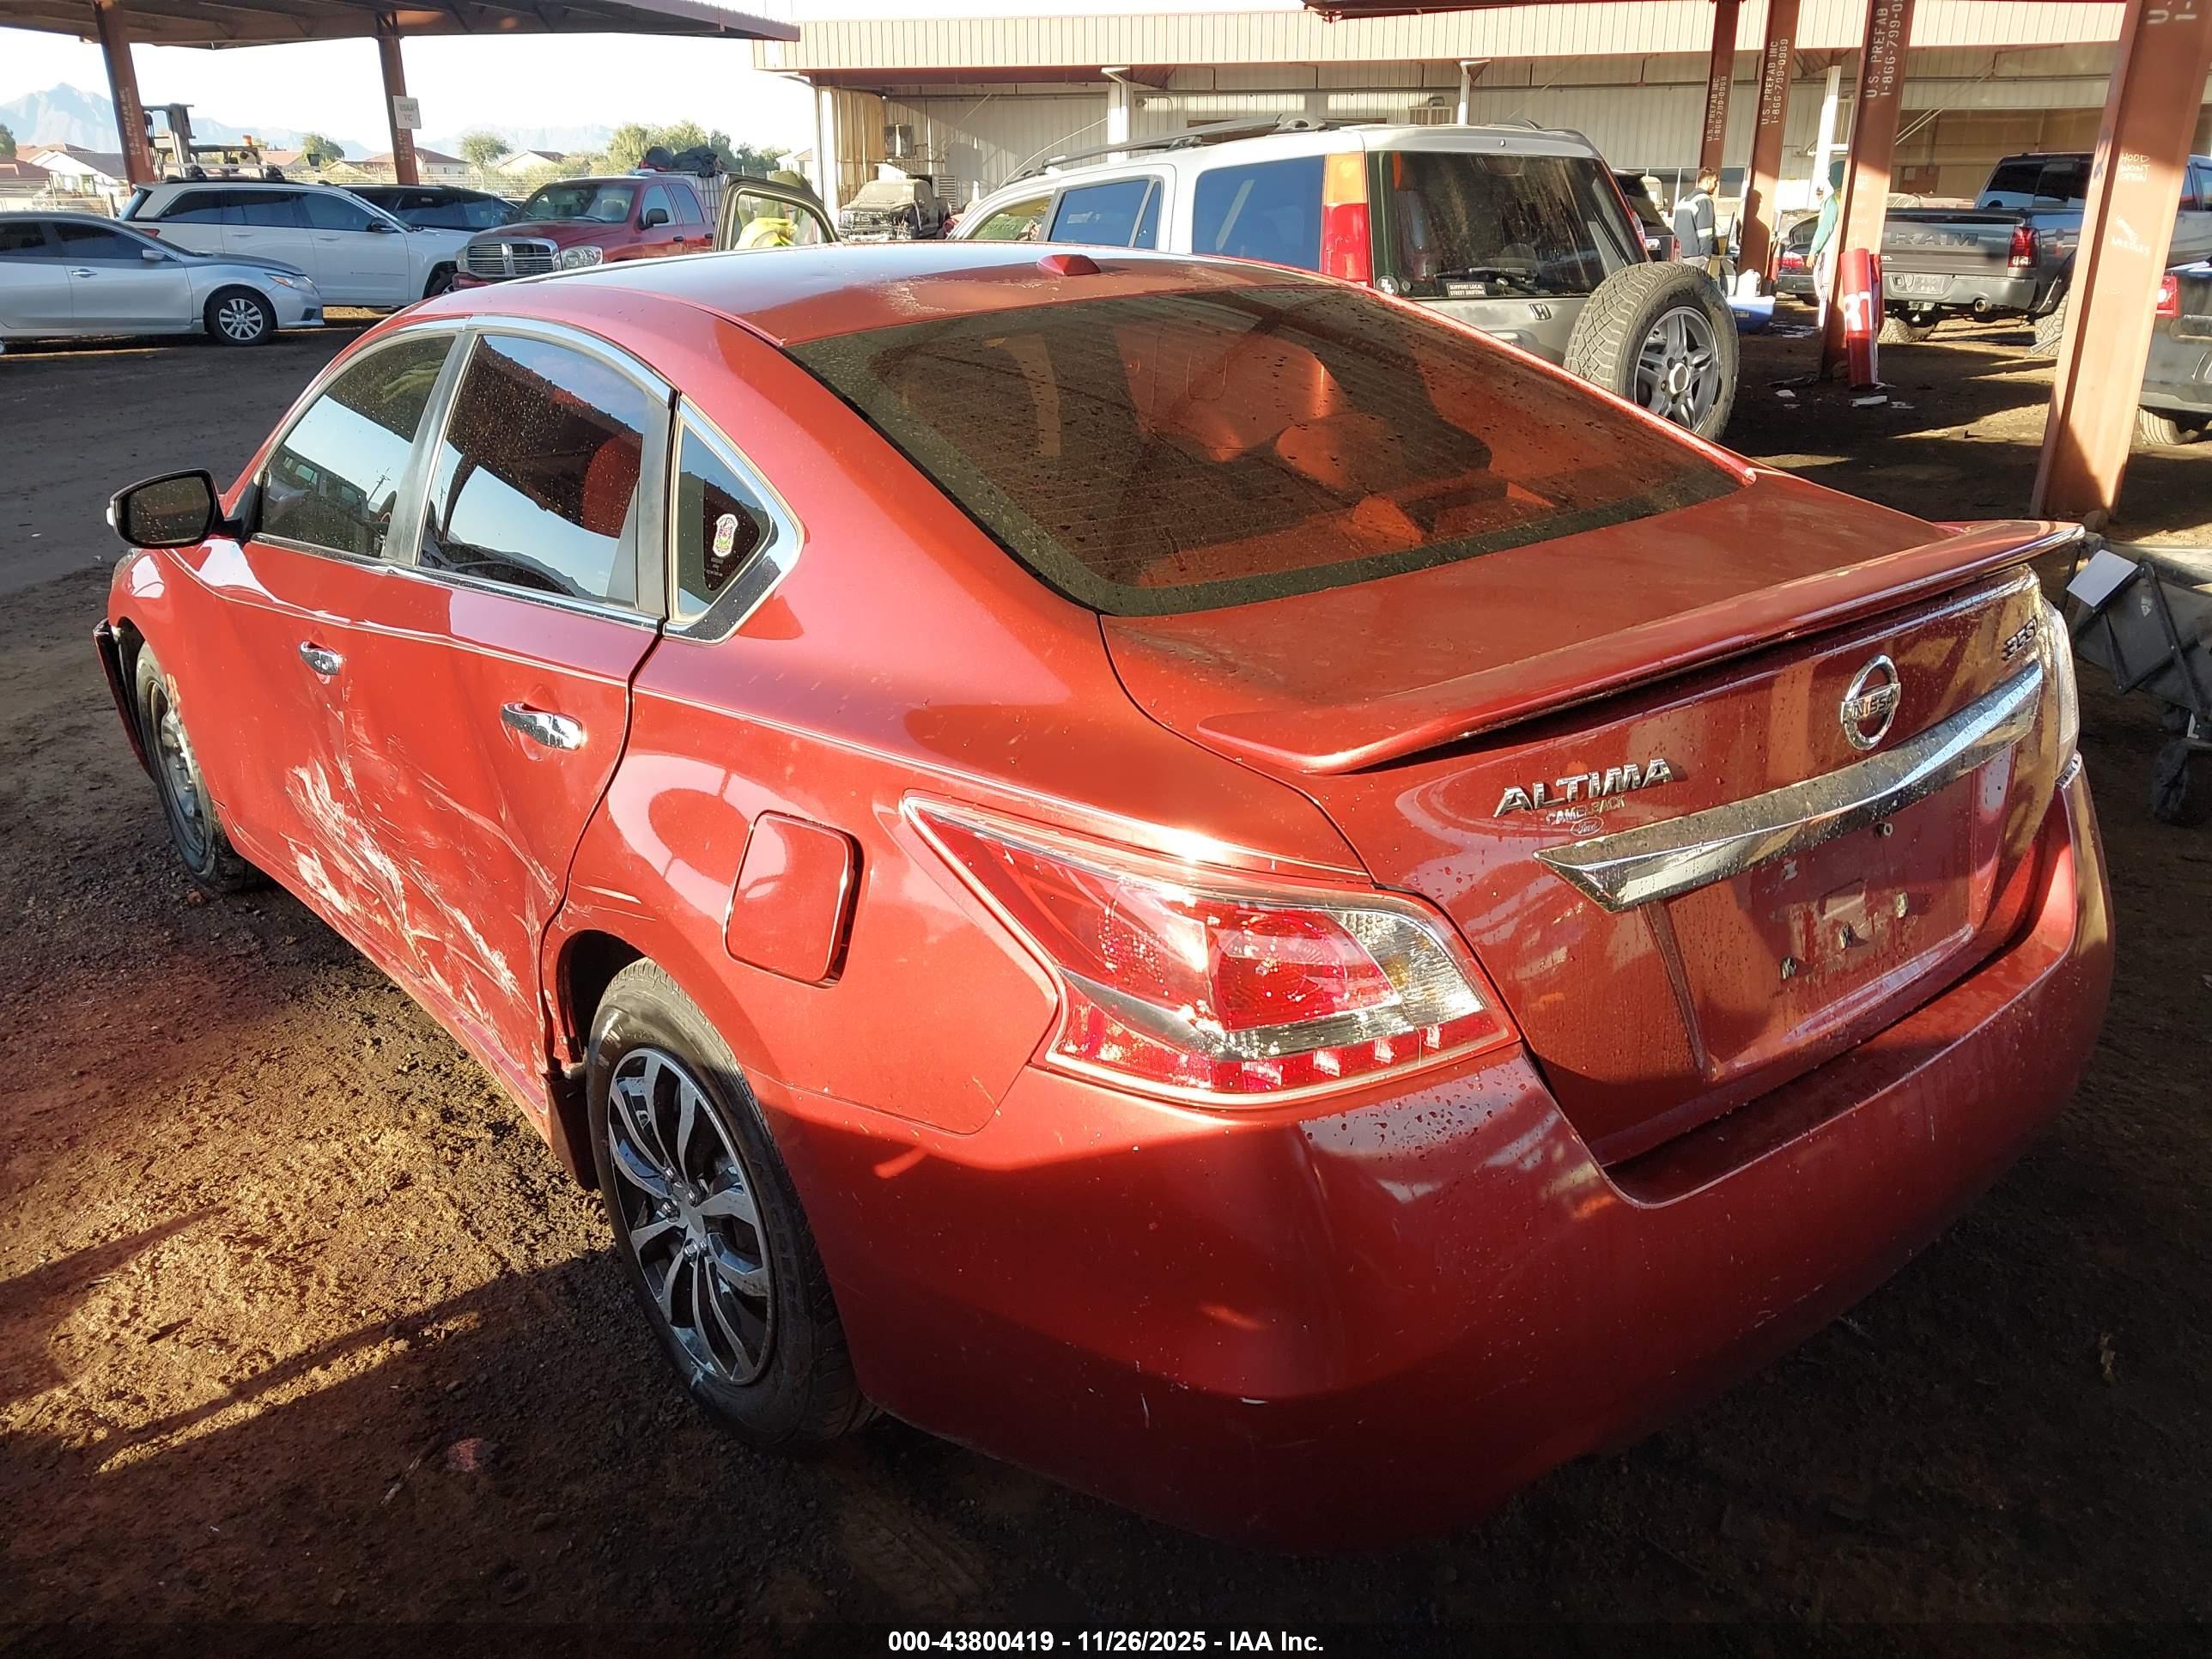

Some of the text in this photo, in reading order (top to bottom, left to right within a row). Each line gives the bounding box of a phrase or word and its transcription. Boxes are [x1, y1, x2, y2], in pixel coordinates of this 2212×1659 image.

[1865, 8, 1888, 98] U.S. PREFAB
[1764, 62, 1776, 100] PREFAB
[1709, 94, 1718, 124] PREFAB
[1761, 106, 1771, 125] U.S.
[1706, 126, 1715, 142] U.S.
[1888, 233, 1978, 247] RAM
[1492, 757, 1674, 817] ALTIMA
[1546, 794, 1626, 826] CAMELBACK
[1575, 820, 1600, 836] Ford
